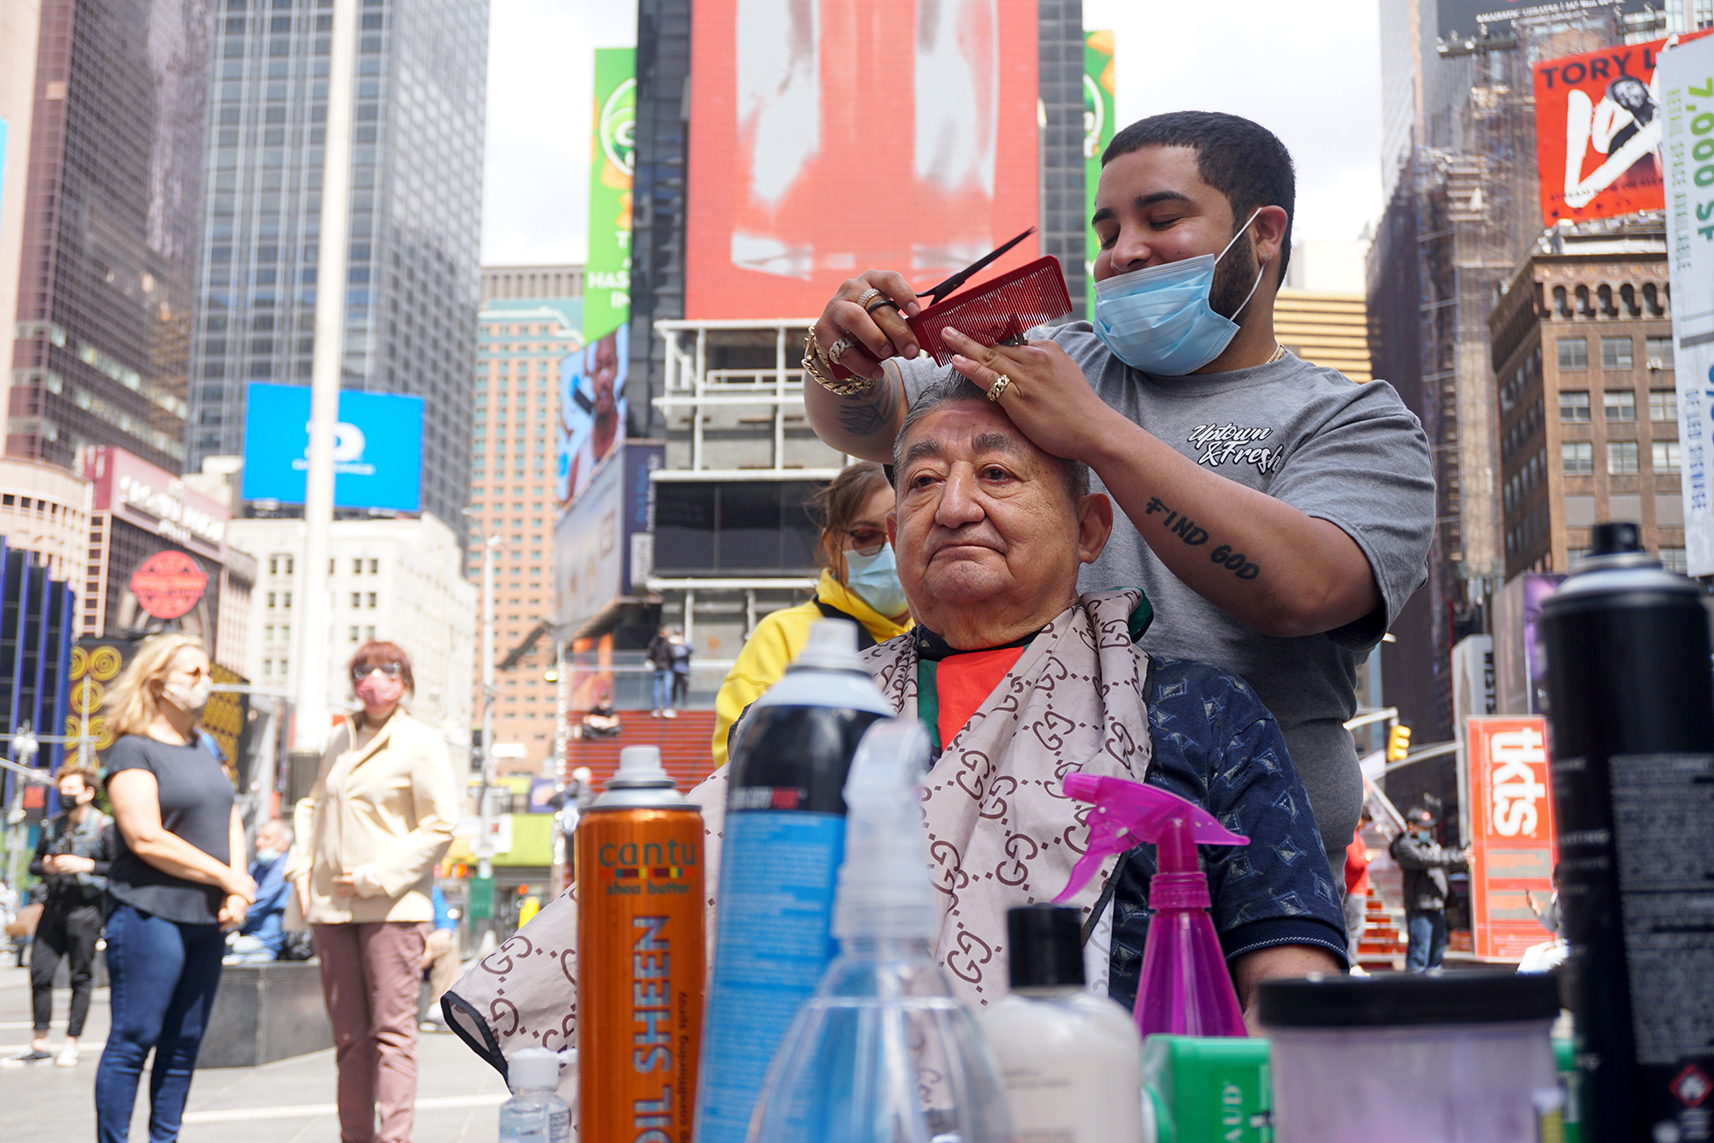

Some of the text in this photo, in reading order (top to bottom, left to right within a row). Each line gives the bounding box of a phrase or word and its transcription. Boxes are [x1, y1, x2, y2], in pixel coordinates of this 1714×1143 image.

[1540, 52, 1631, 89] TORY
[1686, 77, 1714, 188] 7,000
[1667, 88, 1693, 273] RETAIL SPACE AVAILABLE
[588, 270, 631, 289] HAS
[1187, 423, 1272, 450] Uptown
[1686, 411, 1703, 441] LED
[1689, 445, 1707, 512] SIGNAGE
[1145, 497, 1260, 580] FIND GOD
[1491, 727, 1546, 837] tkts
[599, 838, 696, 868] cantu
[607, 880, 689, 896] shea butter
[633, 915, 672, 1074] SHEEN
